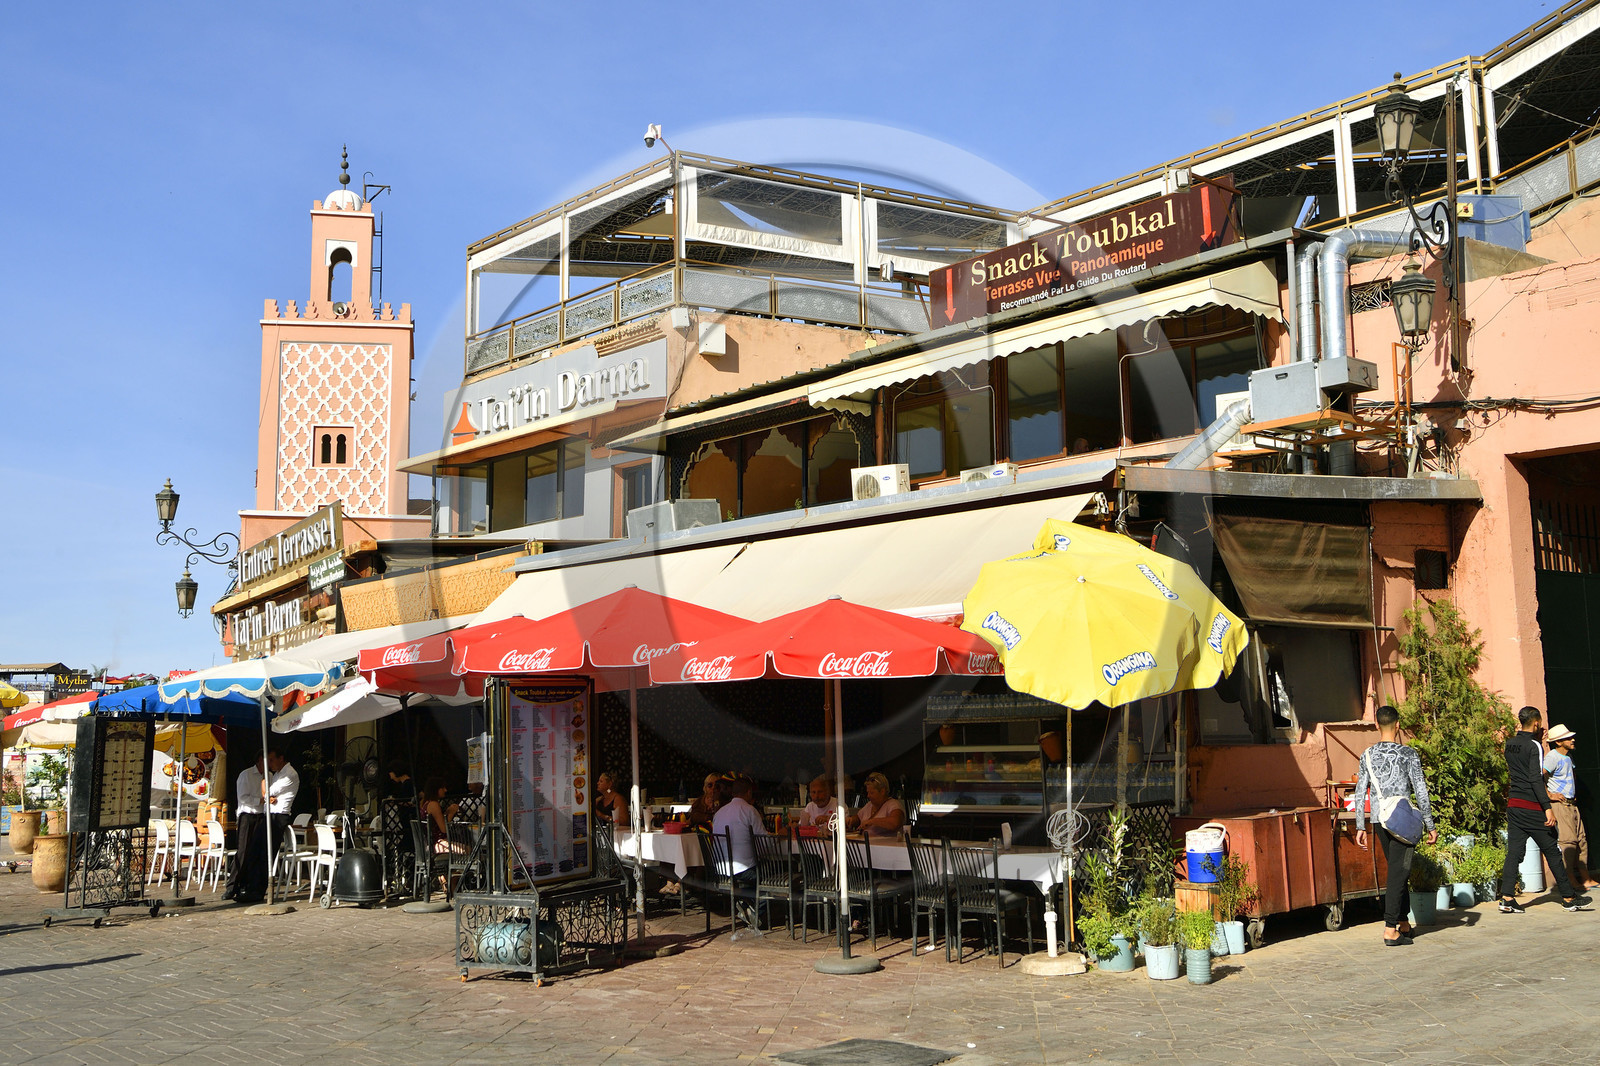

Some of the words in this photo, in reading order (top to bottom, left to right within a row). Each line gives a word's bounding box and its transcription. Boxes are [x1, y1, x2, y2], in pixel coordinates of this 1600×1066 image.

[971, 243, 1050, 286] Snack
[1057, 199, 1177, 258] Toubkal
[984, 275, 1035, 301] Terrasse
[1037, 269, 1061, 286] Vue
[1071, 238, 1164, 276] Panoramique
[1000, 289, 1049, 311] Recommandé
[1051, 286, 1065, 296] Par
[1065, 283, 1075, 292] Le
[1076, 277, 1100, 289] Guide
[1101, 272, 1114, 281] Du
[1115, 262, 1147, 278] Routard
[557, 357, 650, 412] Darna
[242, 541, 274, 583] Entrée
[276, 516, 328, 566] Terrasse
[1136, 564, 1179, 600] ORANGINA
[265, 598, 301, 636] Darna
[982, 611, 1022, 651] ORANGINA
[1207, 612, 1231, 654] ORANGINA
[382, 643, 424, 664] Coca-Cola
[499, 647, 557, 671] Coca-Cola
[680, 655, 736, 681] Coca-Cola
[818, 650, 893, 677] Coca-Cola
[1102, 651, 1157, 686] ORANGINA
[55, 675, 88, 689] Mythe
